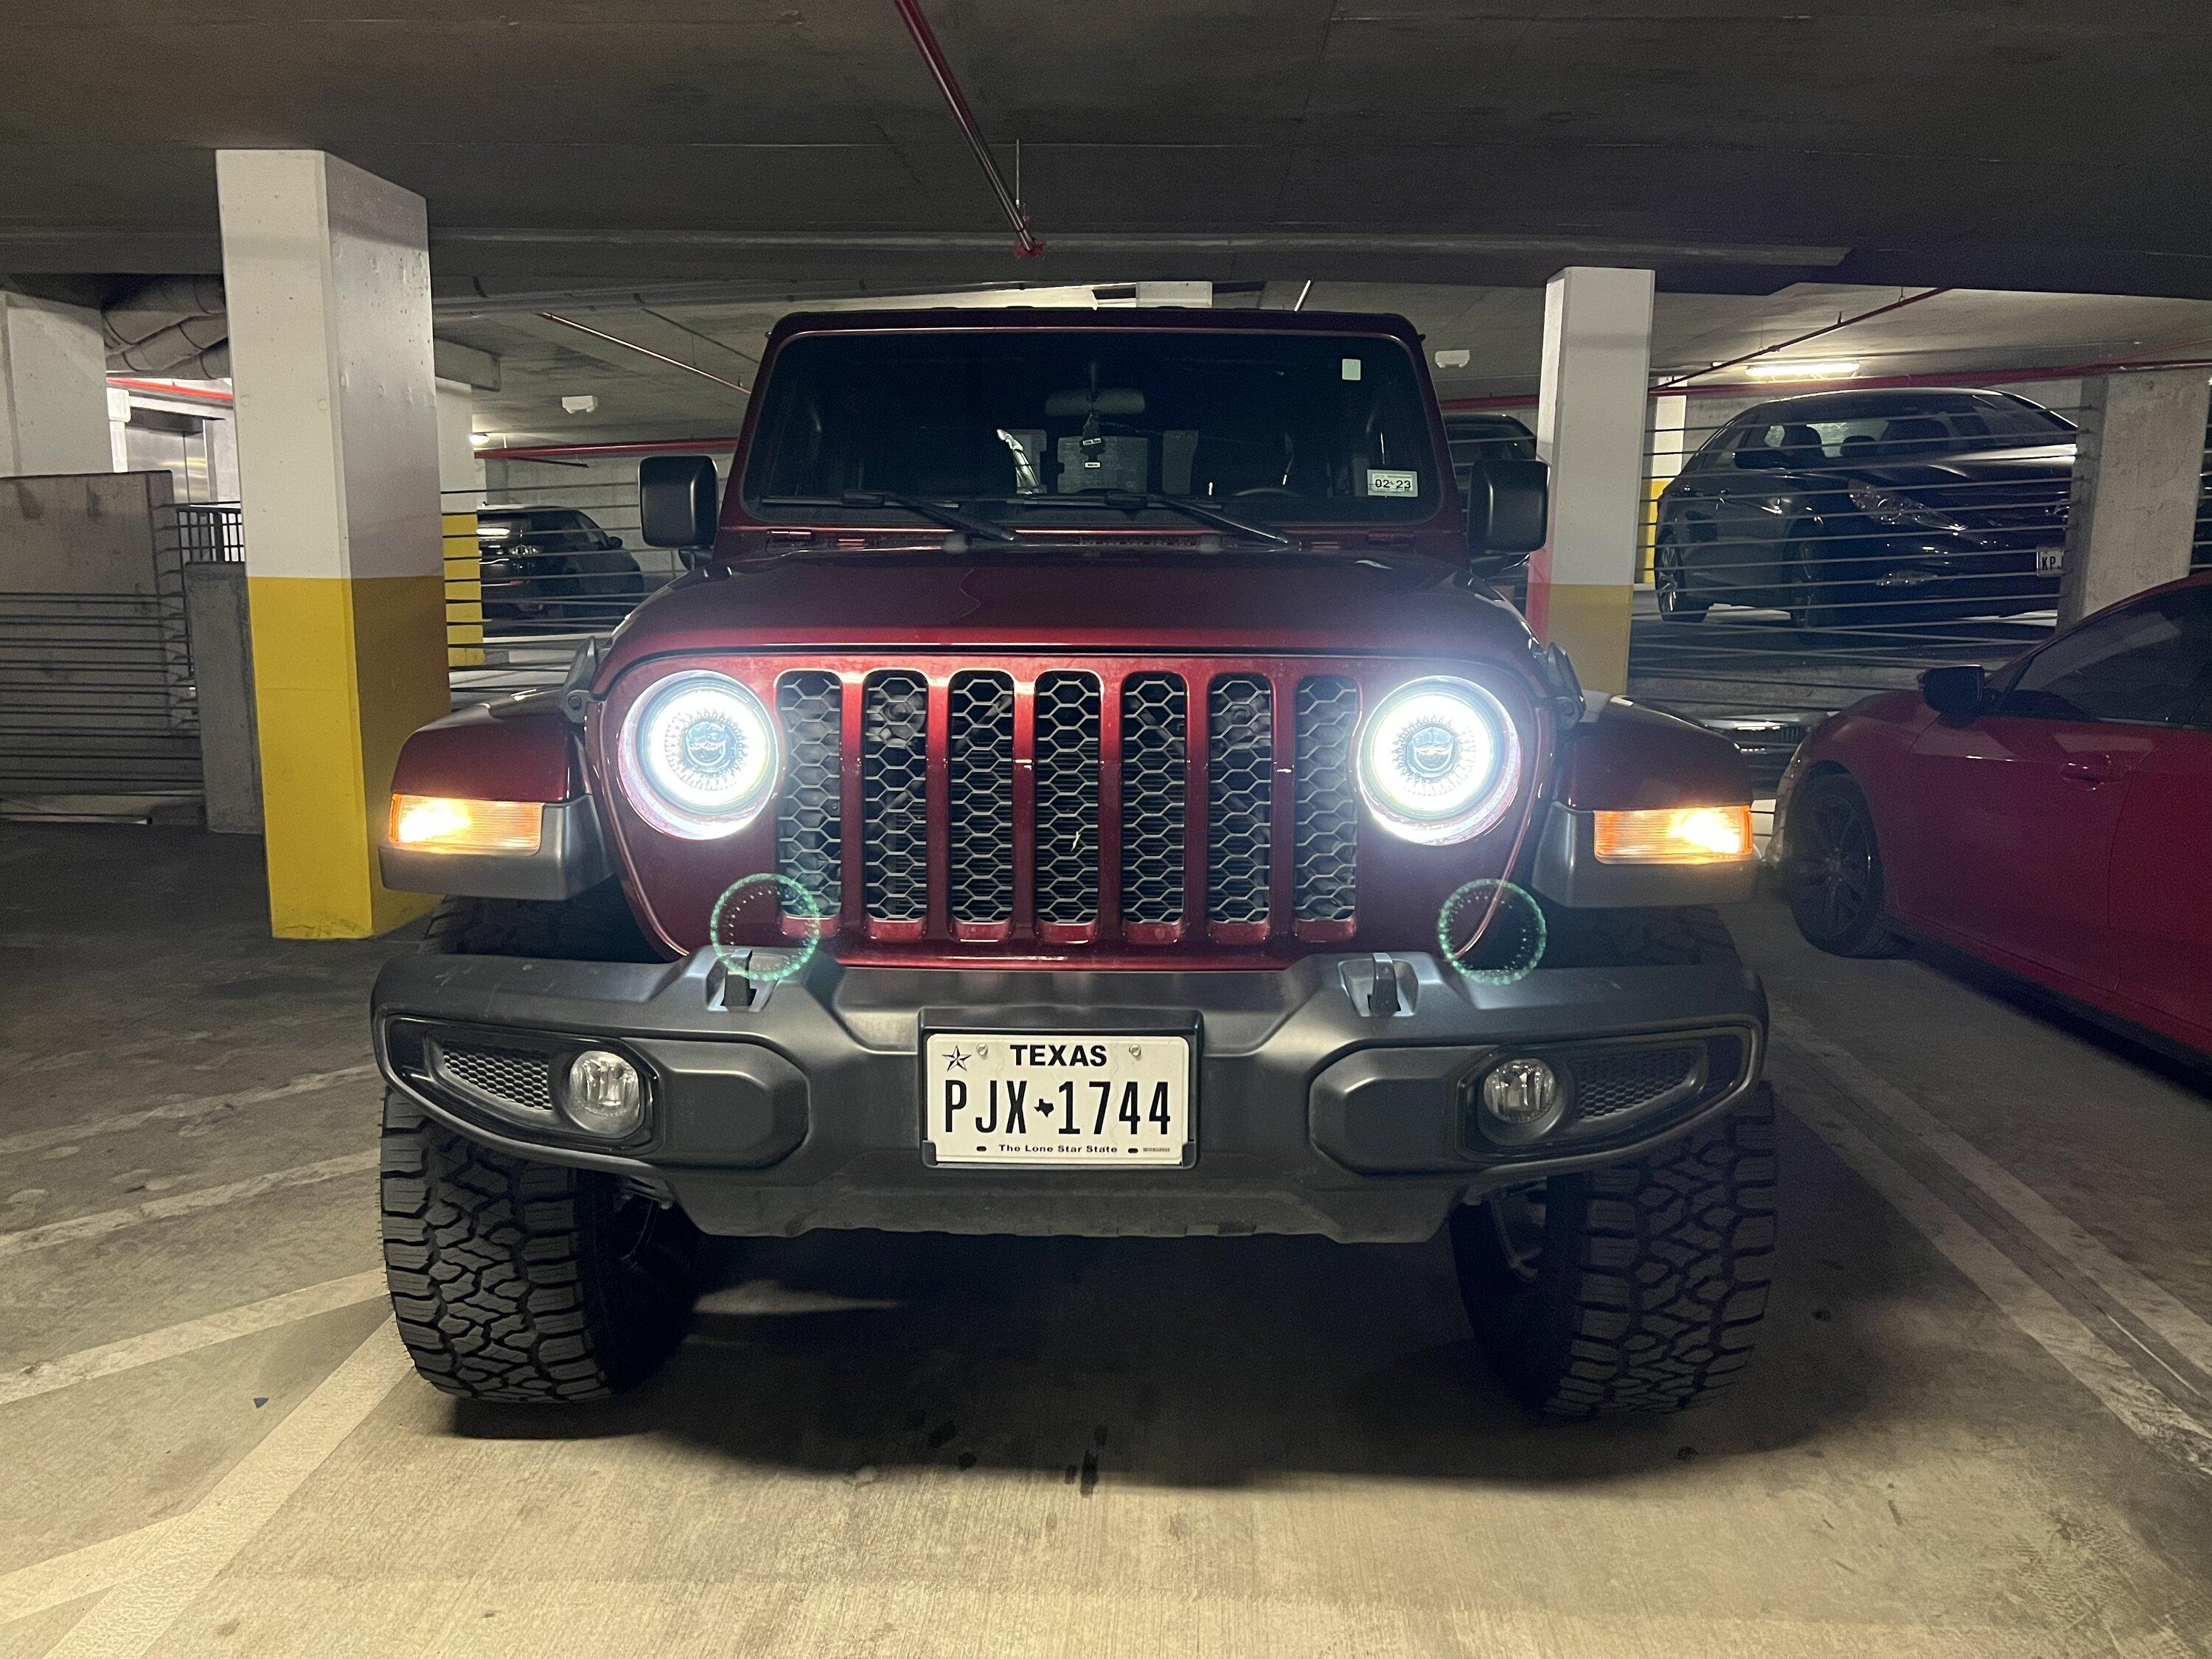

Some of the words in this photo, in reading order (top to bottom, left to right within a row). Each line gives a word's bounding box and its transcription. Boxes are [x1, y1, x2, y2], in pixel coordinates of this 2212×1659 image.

[1375, 479, 1391, 488] 02
[1396, 480, 1411, 489] 23
[1010, 1045, 1107, 1066] TEXAS
